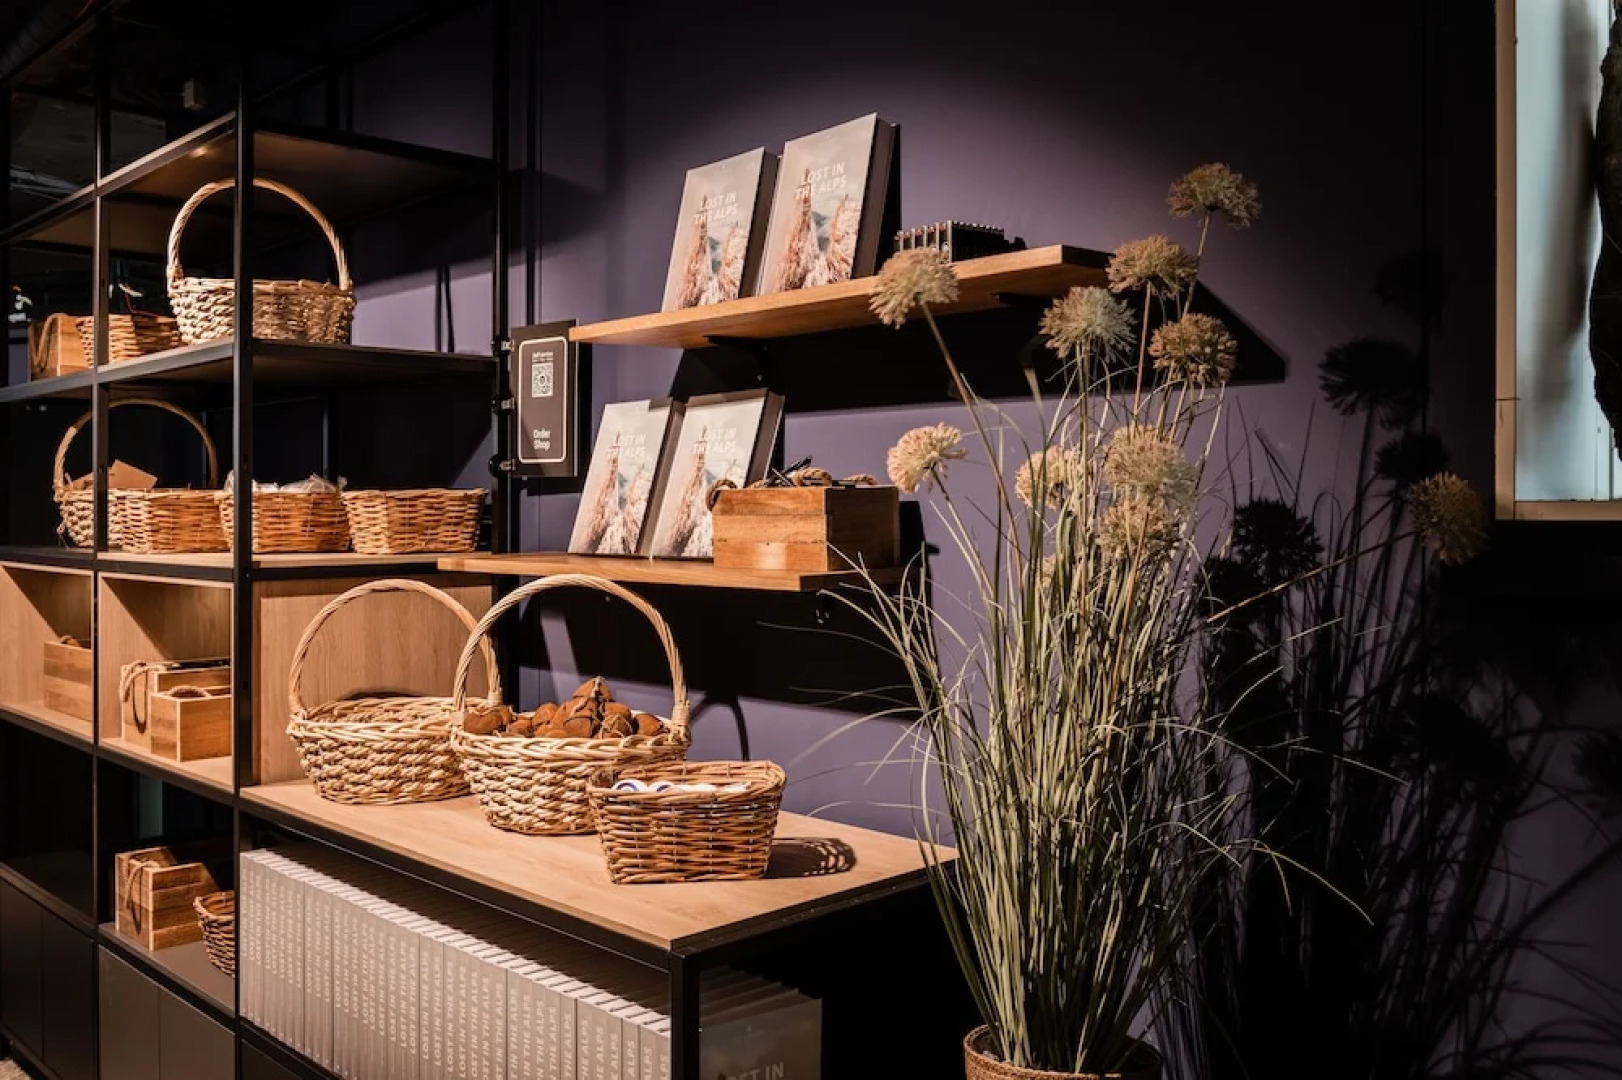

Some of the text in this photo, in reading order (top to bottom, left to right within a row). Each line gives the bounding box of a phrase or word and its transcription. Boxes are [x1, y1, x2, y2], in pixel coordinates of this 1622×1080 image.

[802, 161, 846, 187] LOST IN
[795, 174, 848, 200] THE ALPS
[701, 192, 737, 210] LOST IN
[695, 203, 739, 225] THE ALPS
[533, 428, 551, 439] Order
[533, 439, 551, 451] Shop
